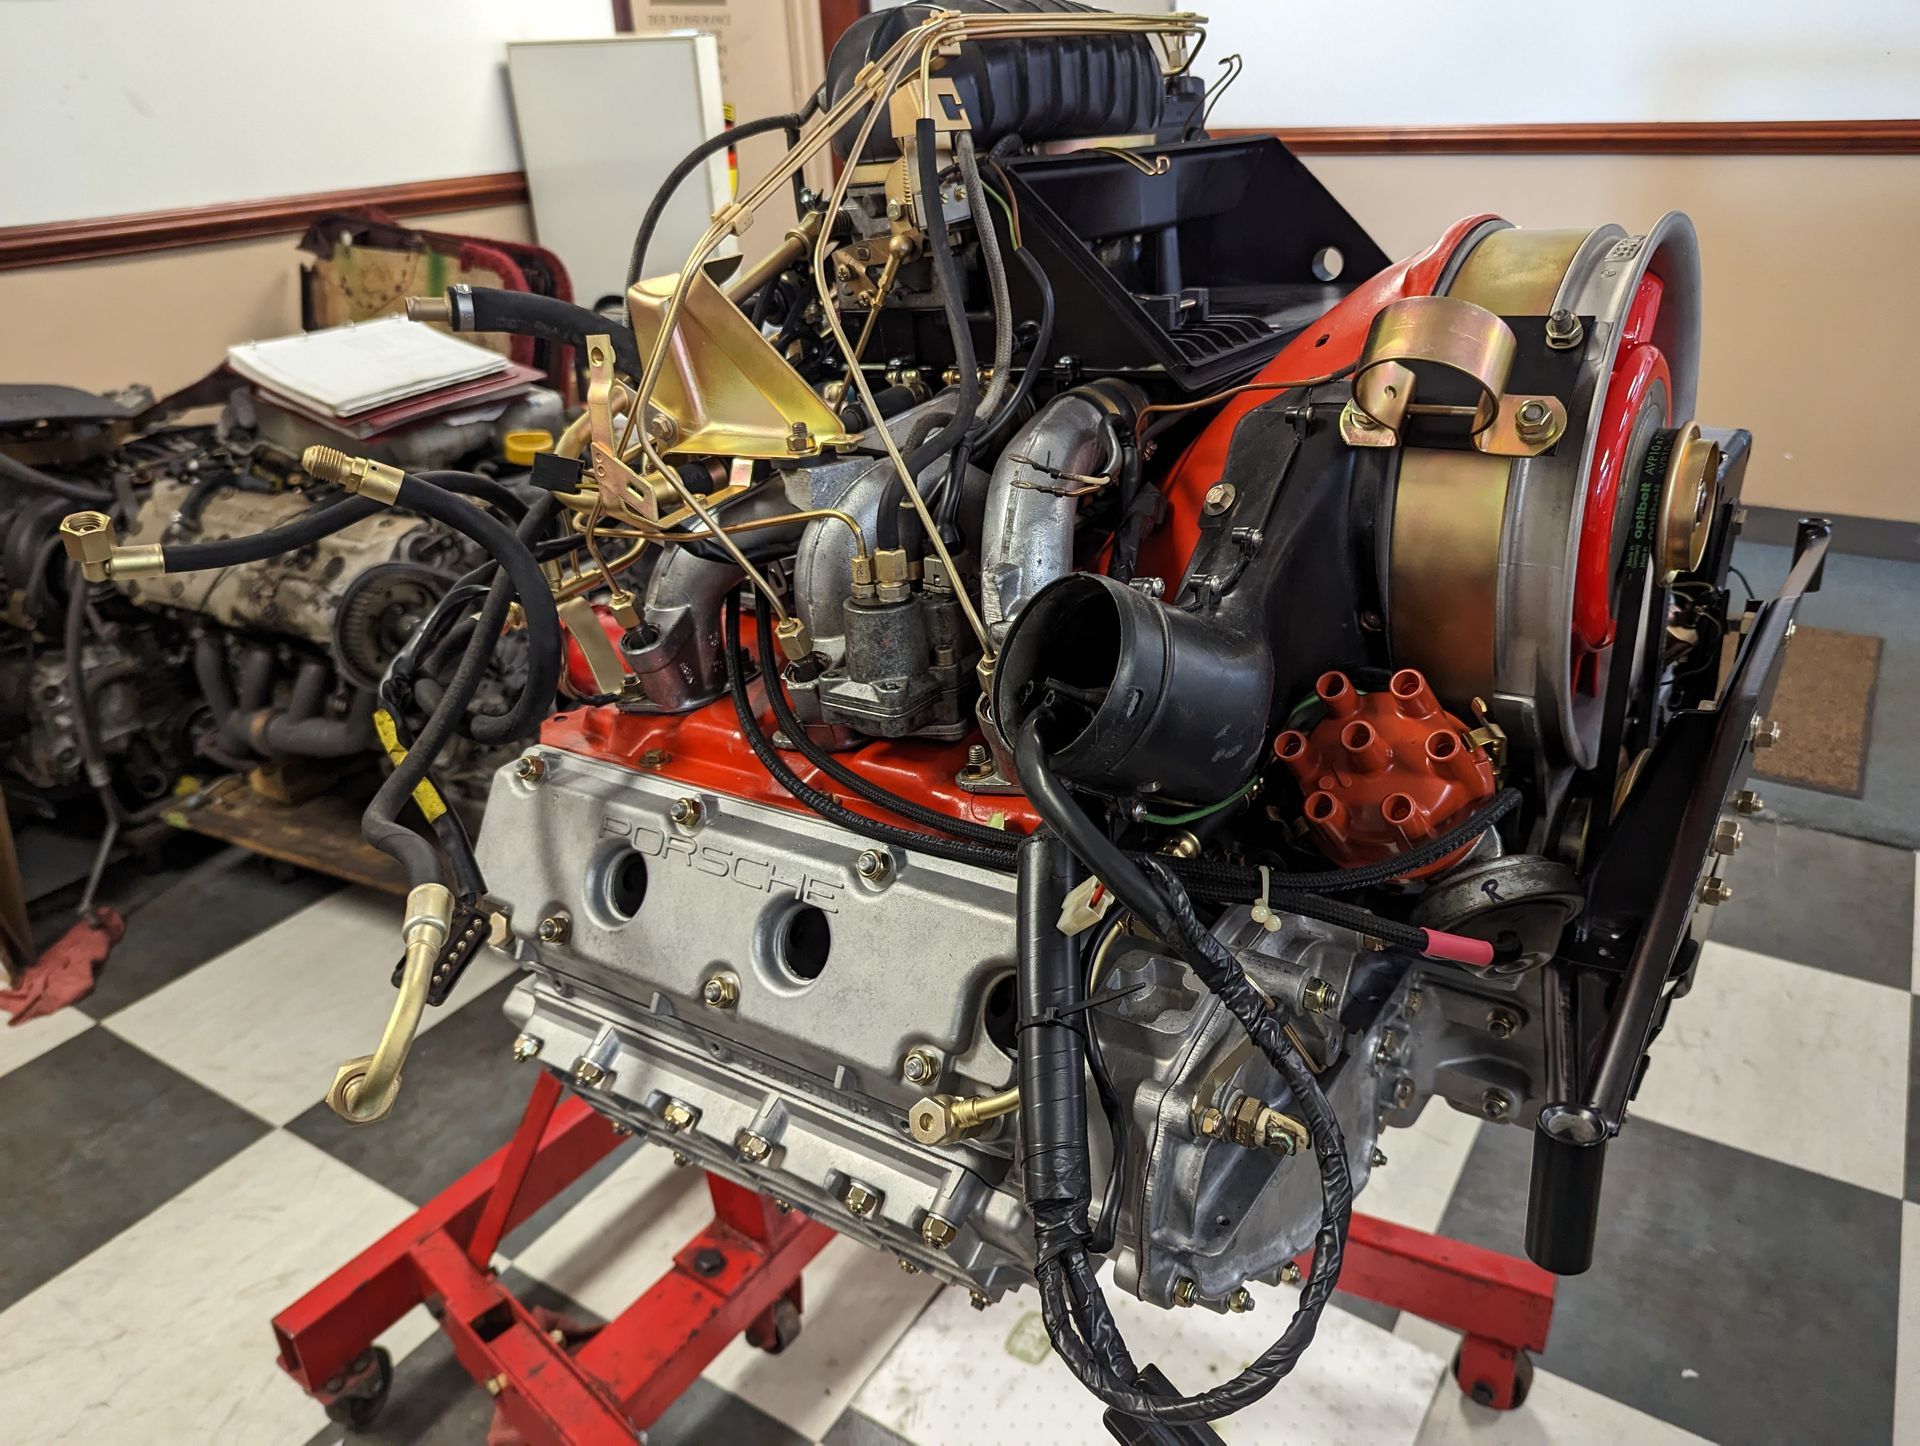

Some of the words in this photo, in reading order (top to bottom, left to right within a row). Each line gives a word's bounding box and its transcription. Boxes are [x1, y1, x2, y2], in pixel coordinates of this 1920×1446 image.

[1634, 482, 1652, 540] optibelt
[599, 816, 845, 914] PORSCHE
[1481, 879, 1505, 904] R
